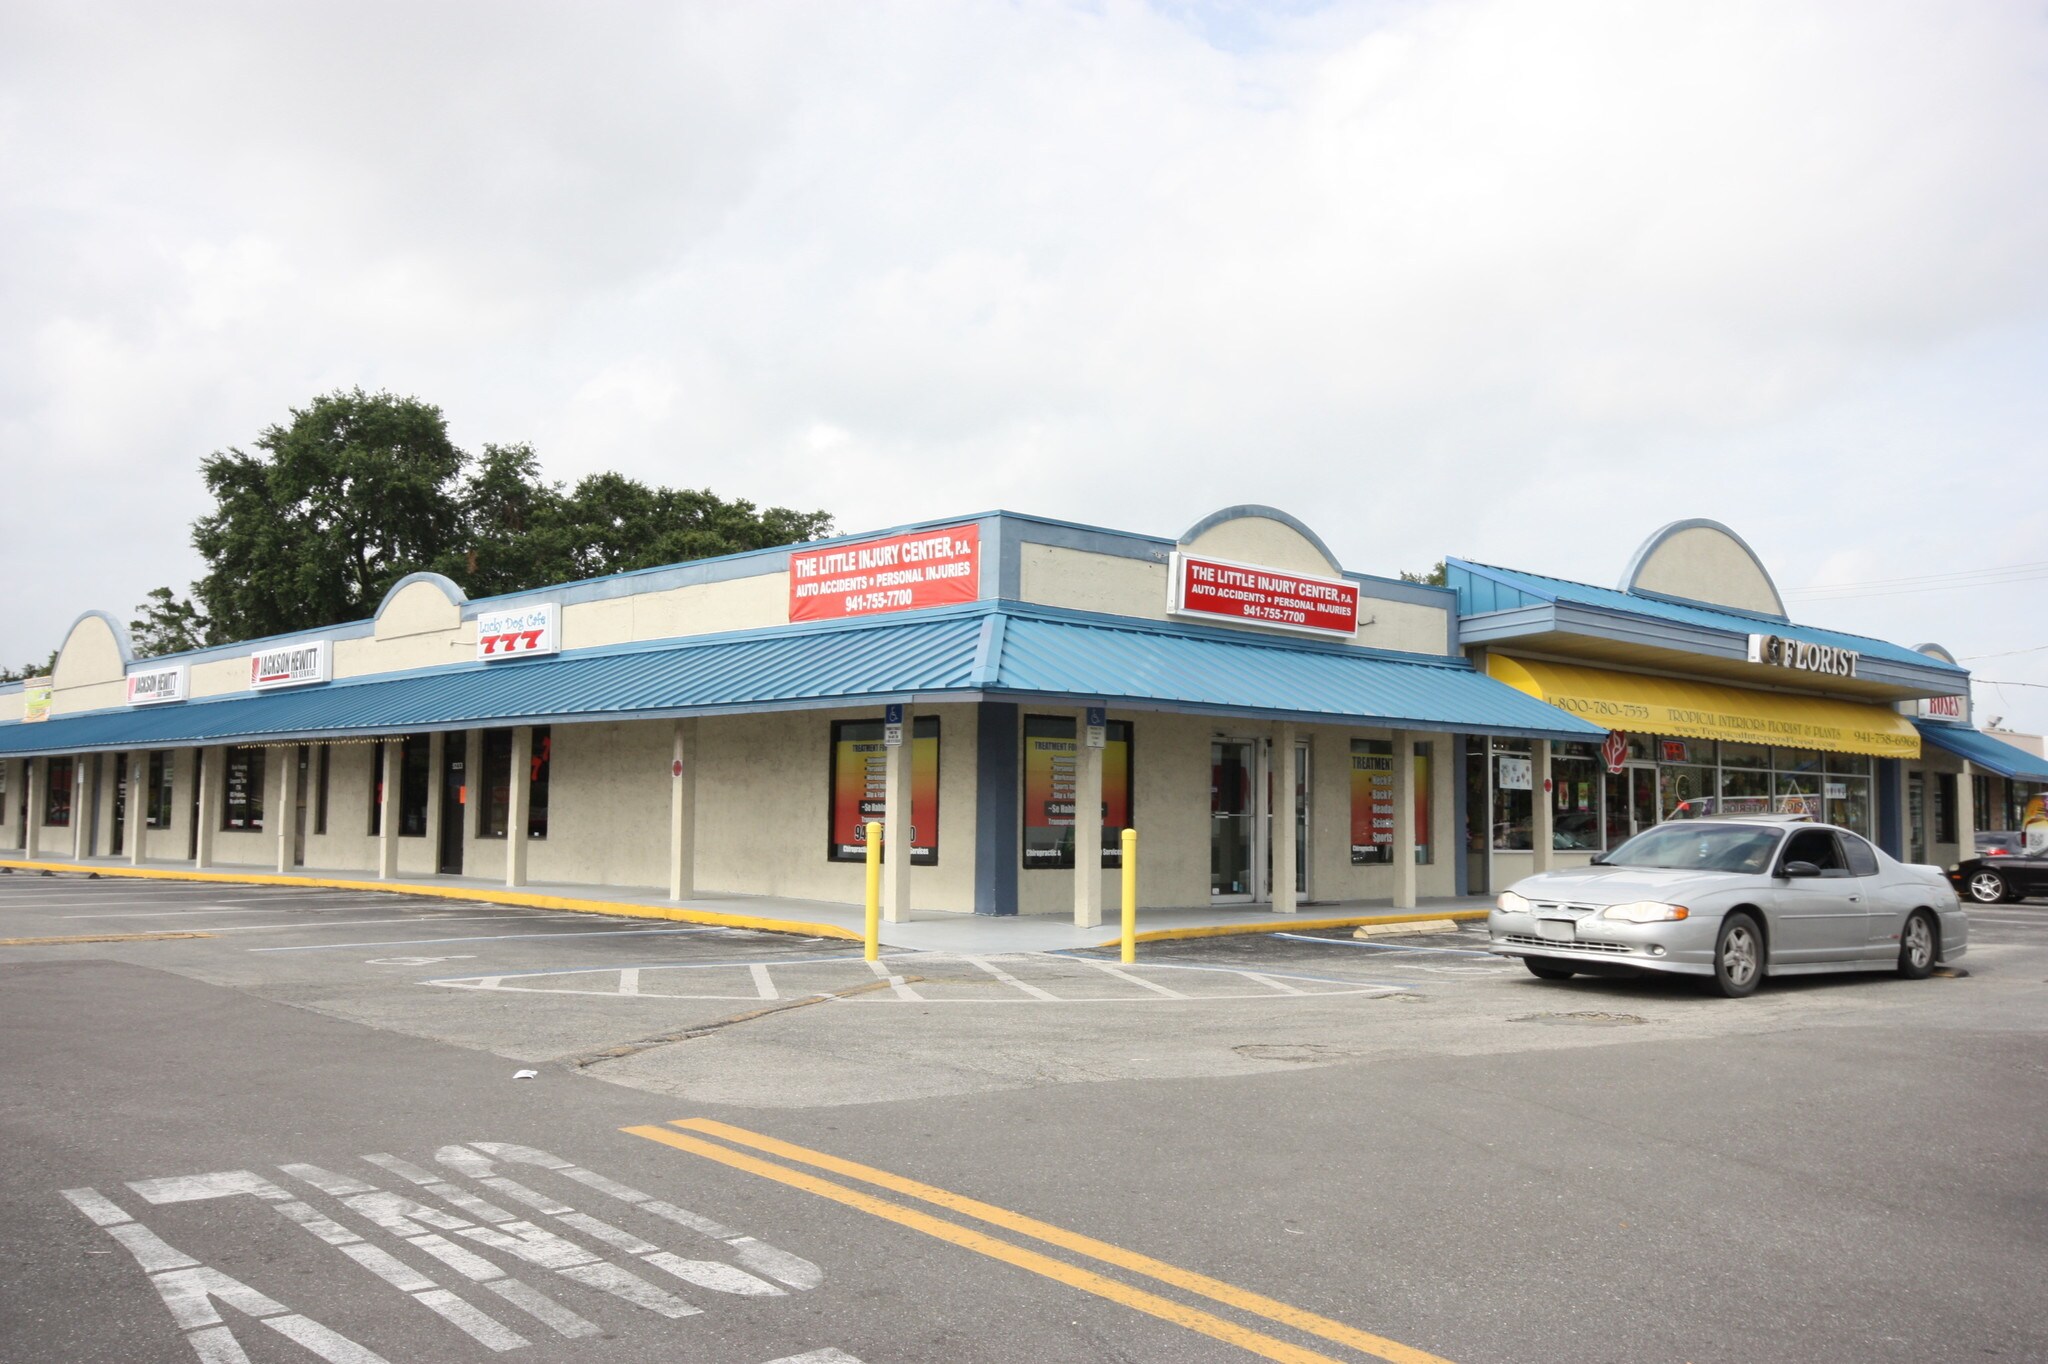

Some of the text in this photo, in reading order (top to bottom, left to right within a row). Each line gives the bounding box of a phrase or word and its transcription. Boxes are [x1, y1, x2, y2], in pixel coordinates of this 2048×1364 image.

[795, 536, 971, 577] THE LITTLE INJURY CENTER, P.A.
[796, 561, 971, 598] AUTO ACCIDENTS PERSONAL INJURIES
[1191, 566, 1353, 604] THE LITTLE INJURY CENTER, P.A.
[845, 588, 912, 612] 941-755-7700
[1191, 584, 1352, 617] AUTO ACCIDENTS PERSONAL INJURIES
[480, 618, 502, 633] Lucky
[505, 617, 524, 631] Dog
[1243, 604, 1305, 623] 941-755-7700
[480, 629, 545, 654] 777
[259, 648, 317, 676] JACKSON HEWITT
[1783, 638, 1859, 678] FLORIST
[135, 672, 177, 693] JACKSON HEWITT
[1548, 697, 1649, 719] 1-800-780-7553
[1667, 709, 1716, 726] TROPICAL
[1719, 716, 1765, 732] INTERIORS
[1768, 720, 1801, 735] FLORIST
[1813, 726, 1841, 740] PLANTS
[1853, 731, 1919, 748] 941-758-6966
[1035, 742, 1066, 751] TREATMENT
[1352, 756, 1393, 771] TREATMENT
